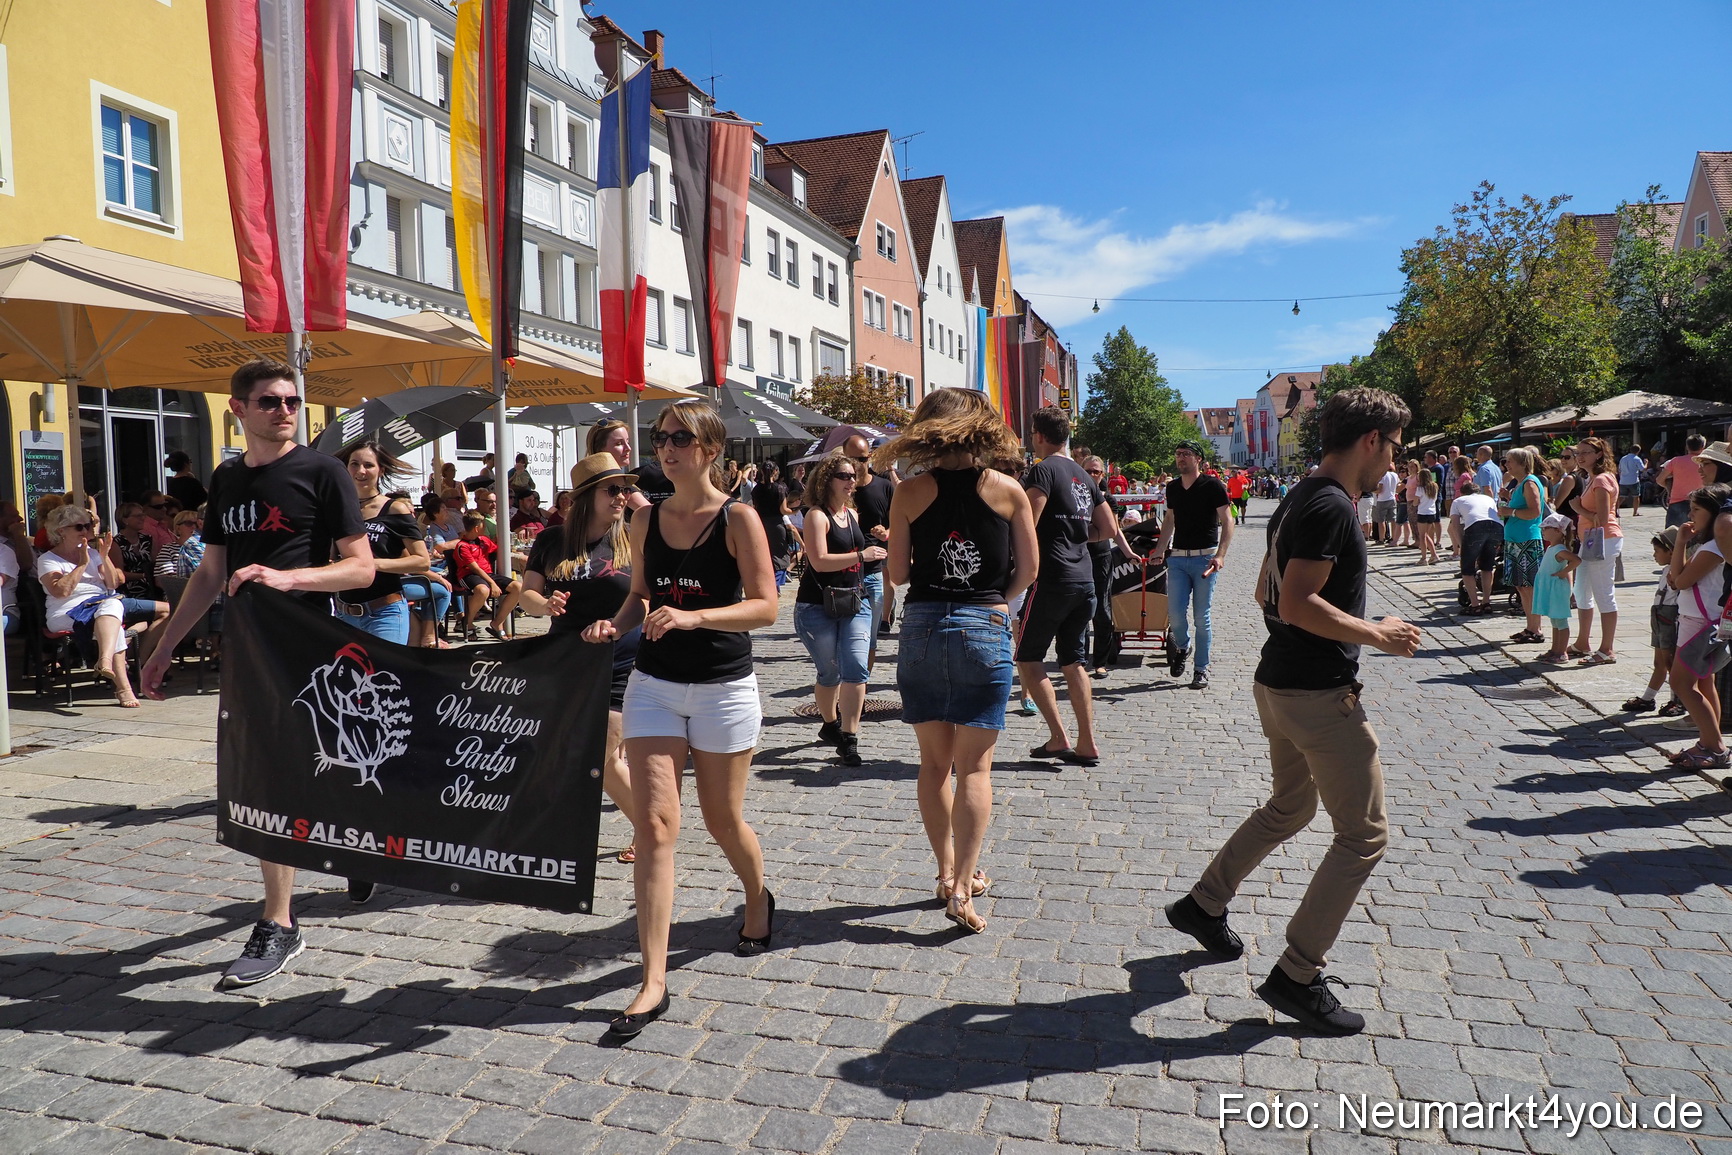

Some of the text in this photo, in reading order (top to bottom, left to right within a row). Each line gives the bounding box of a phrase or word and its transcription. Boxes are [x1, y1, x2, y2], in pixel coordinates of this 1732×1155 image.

[525, 435, 552, 449] 30 Jahre
[461, 660, 527, 695] Kurse
[446, 735, 517, 781] Partys
[440, 774, 511, 812] Shows
[228, 800, 577, 881] WWW.SALSA-NEUMARKT.DE
